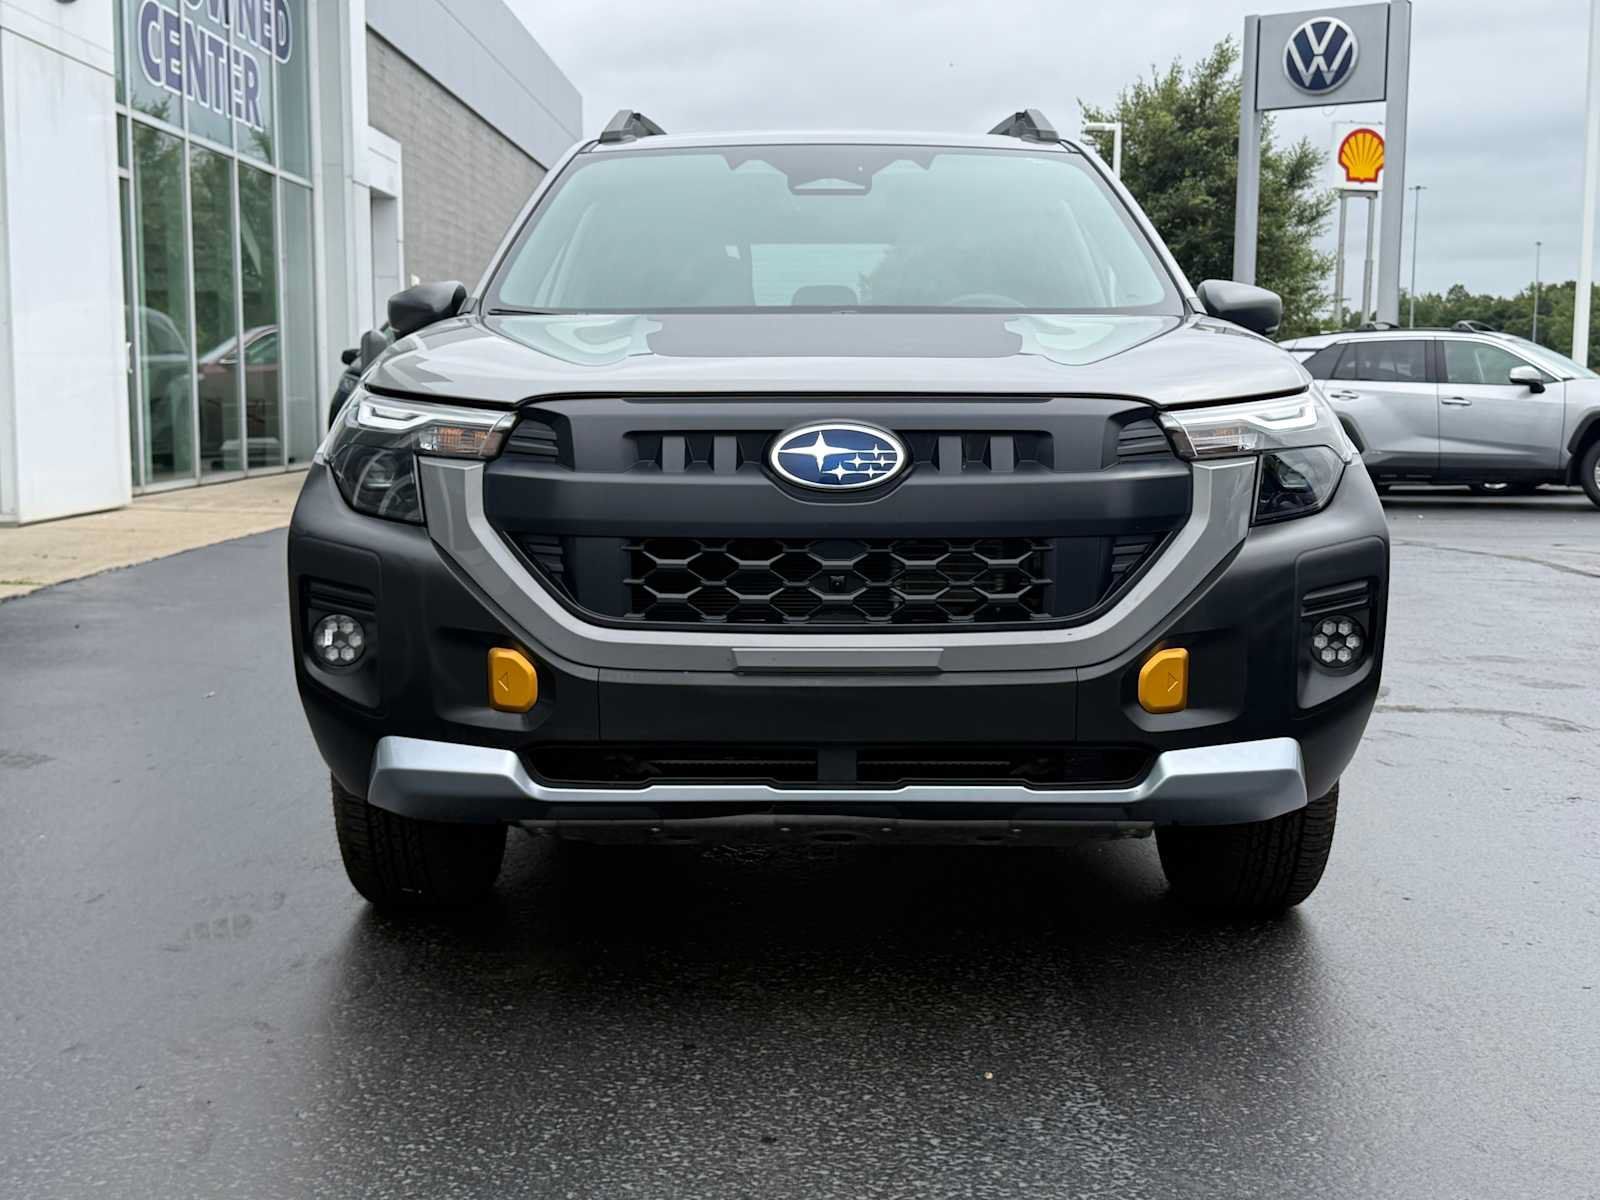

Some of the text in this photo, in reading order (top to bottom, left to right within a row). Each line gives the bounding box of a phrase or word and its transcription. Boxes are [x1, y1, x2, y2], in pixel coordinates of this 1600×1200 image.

[138, 0, 265, 132] CENTER
[184, 0, 292, 64] NED
[1286, 20, 1354, 88] VW
